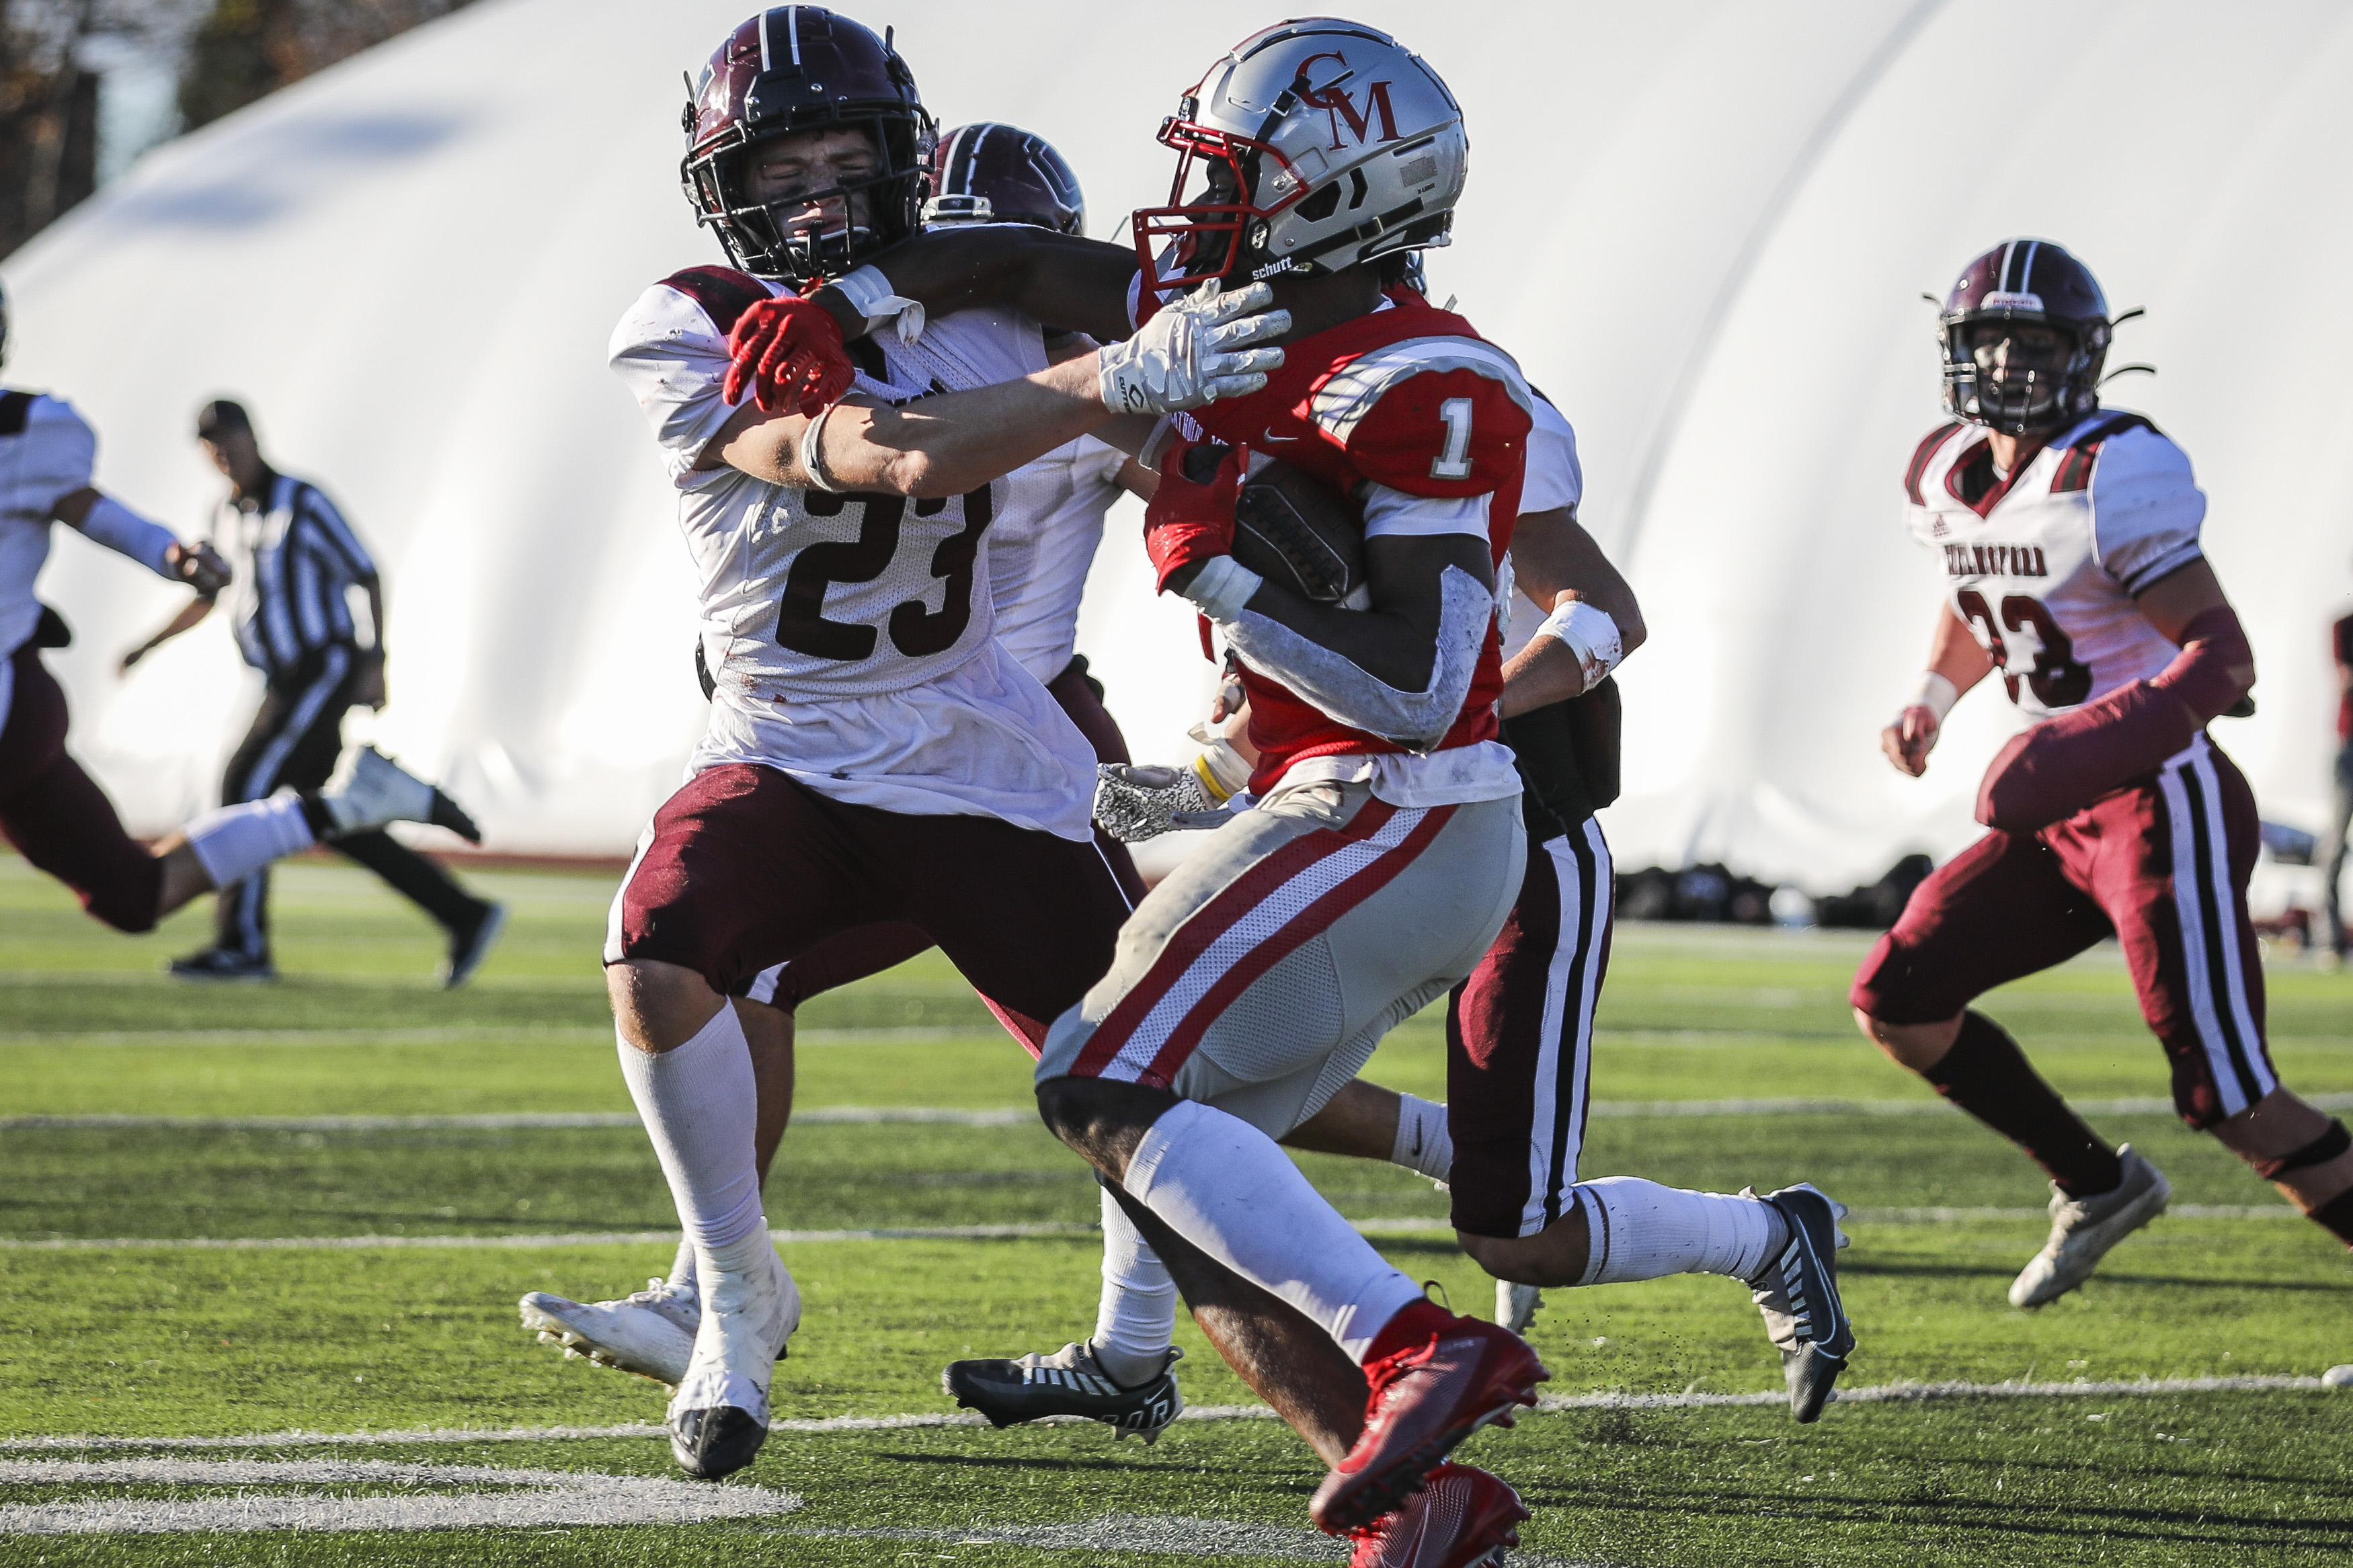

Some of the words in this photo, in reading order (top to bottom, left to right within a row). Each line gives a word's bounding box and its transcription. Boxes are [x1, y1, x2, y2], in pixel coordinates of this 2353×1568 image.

[1294, 50, 1406, 151] CM
[1252, 256, 1291, 280] schutt
[1429, 397, 1473, 479] 1
[775, 483, 993, 661] 23
